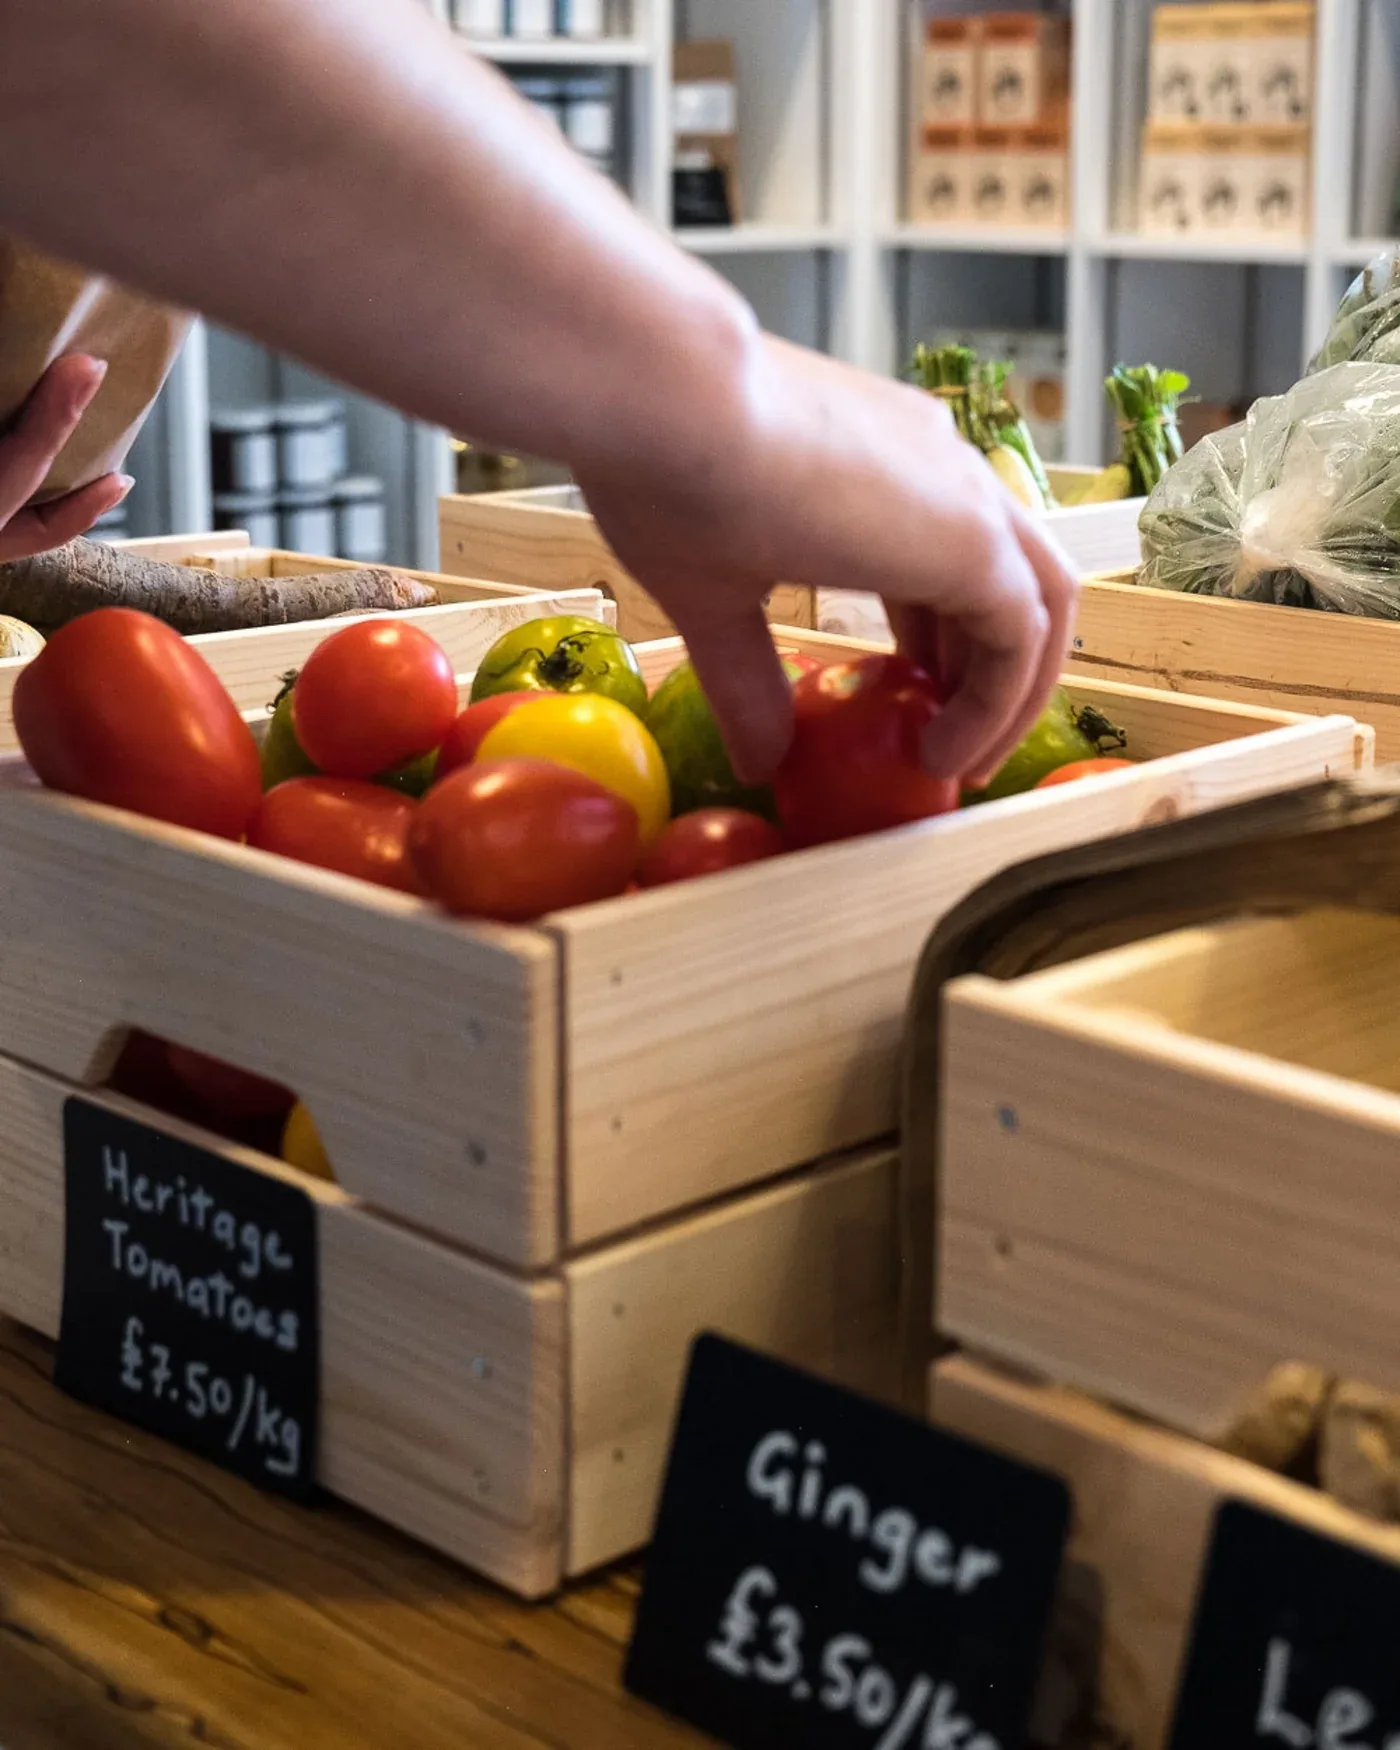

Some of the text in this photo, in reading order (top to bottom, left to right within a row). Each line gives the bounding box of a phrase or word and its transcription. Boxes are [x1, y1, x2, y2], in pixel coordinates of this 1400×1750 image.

[103, 1146, 292, 1277] Heritage
[102, 1219, 299, 1350] Tomatoes
[121, 1317, 299, 1474] £7.50/kg
[747, 1431, 999, 1589] Ginger
[707, 1567, 1002, 1750] £3.50/k
[1257, 1635, 1400, 1750] Le
